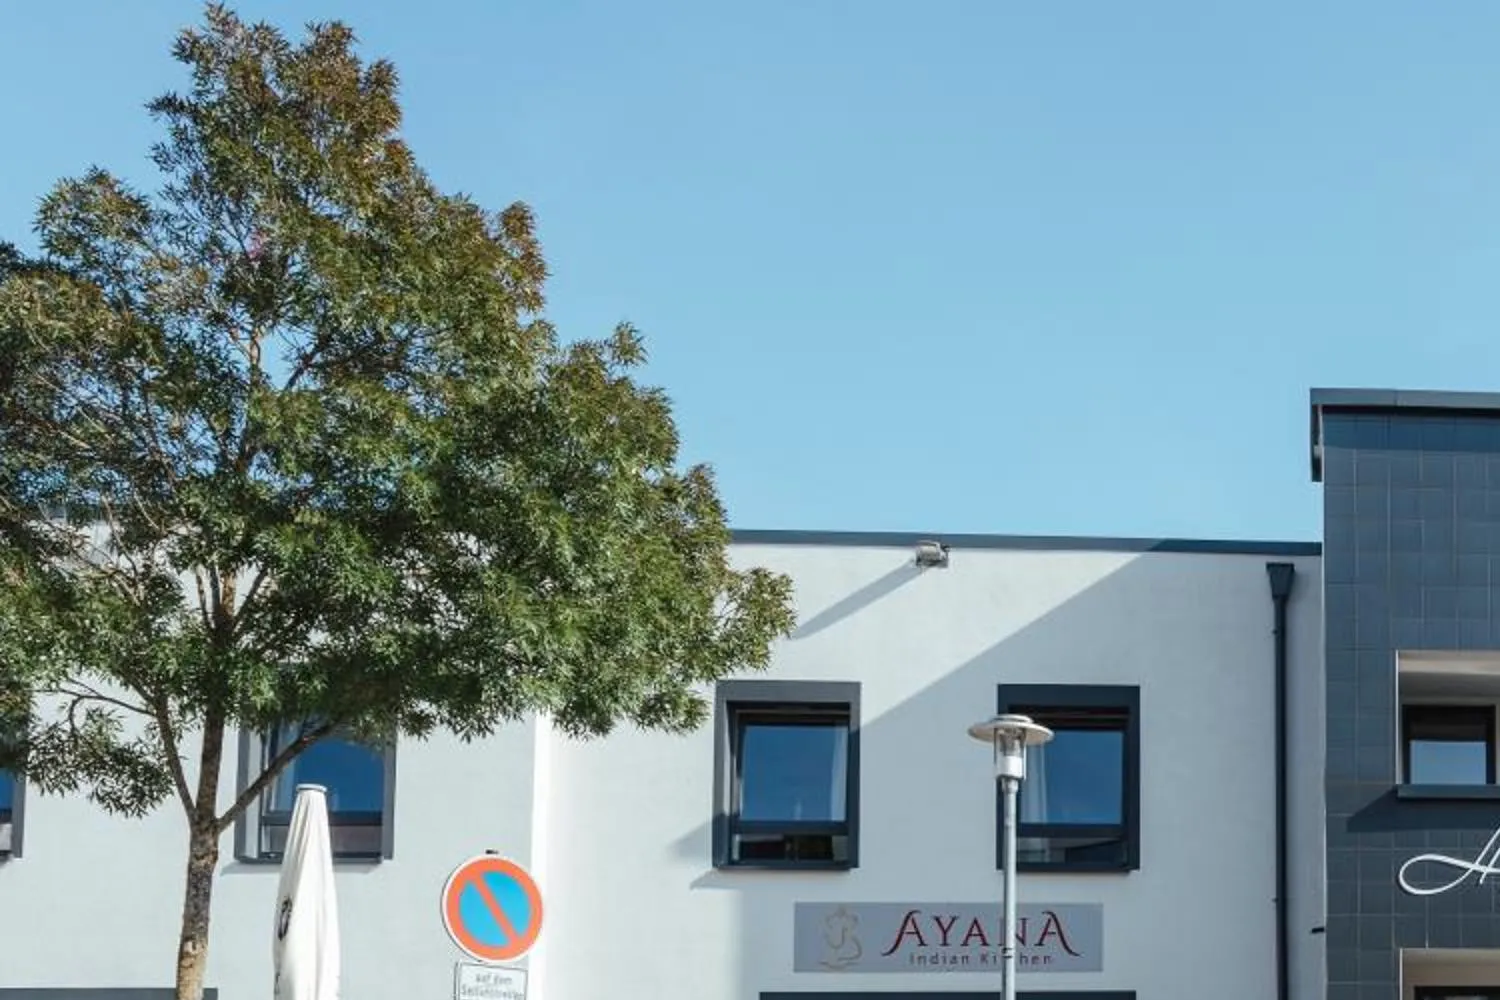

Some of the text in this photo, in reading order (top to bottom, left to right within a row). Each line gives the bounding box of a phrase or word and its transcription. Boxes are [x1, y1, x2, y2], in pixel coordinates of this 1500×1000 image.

[881, 909, 1082, 957] AYANA
[909, 951, 1053, 966] Indian Kihen
